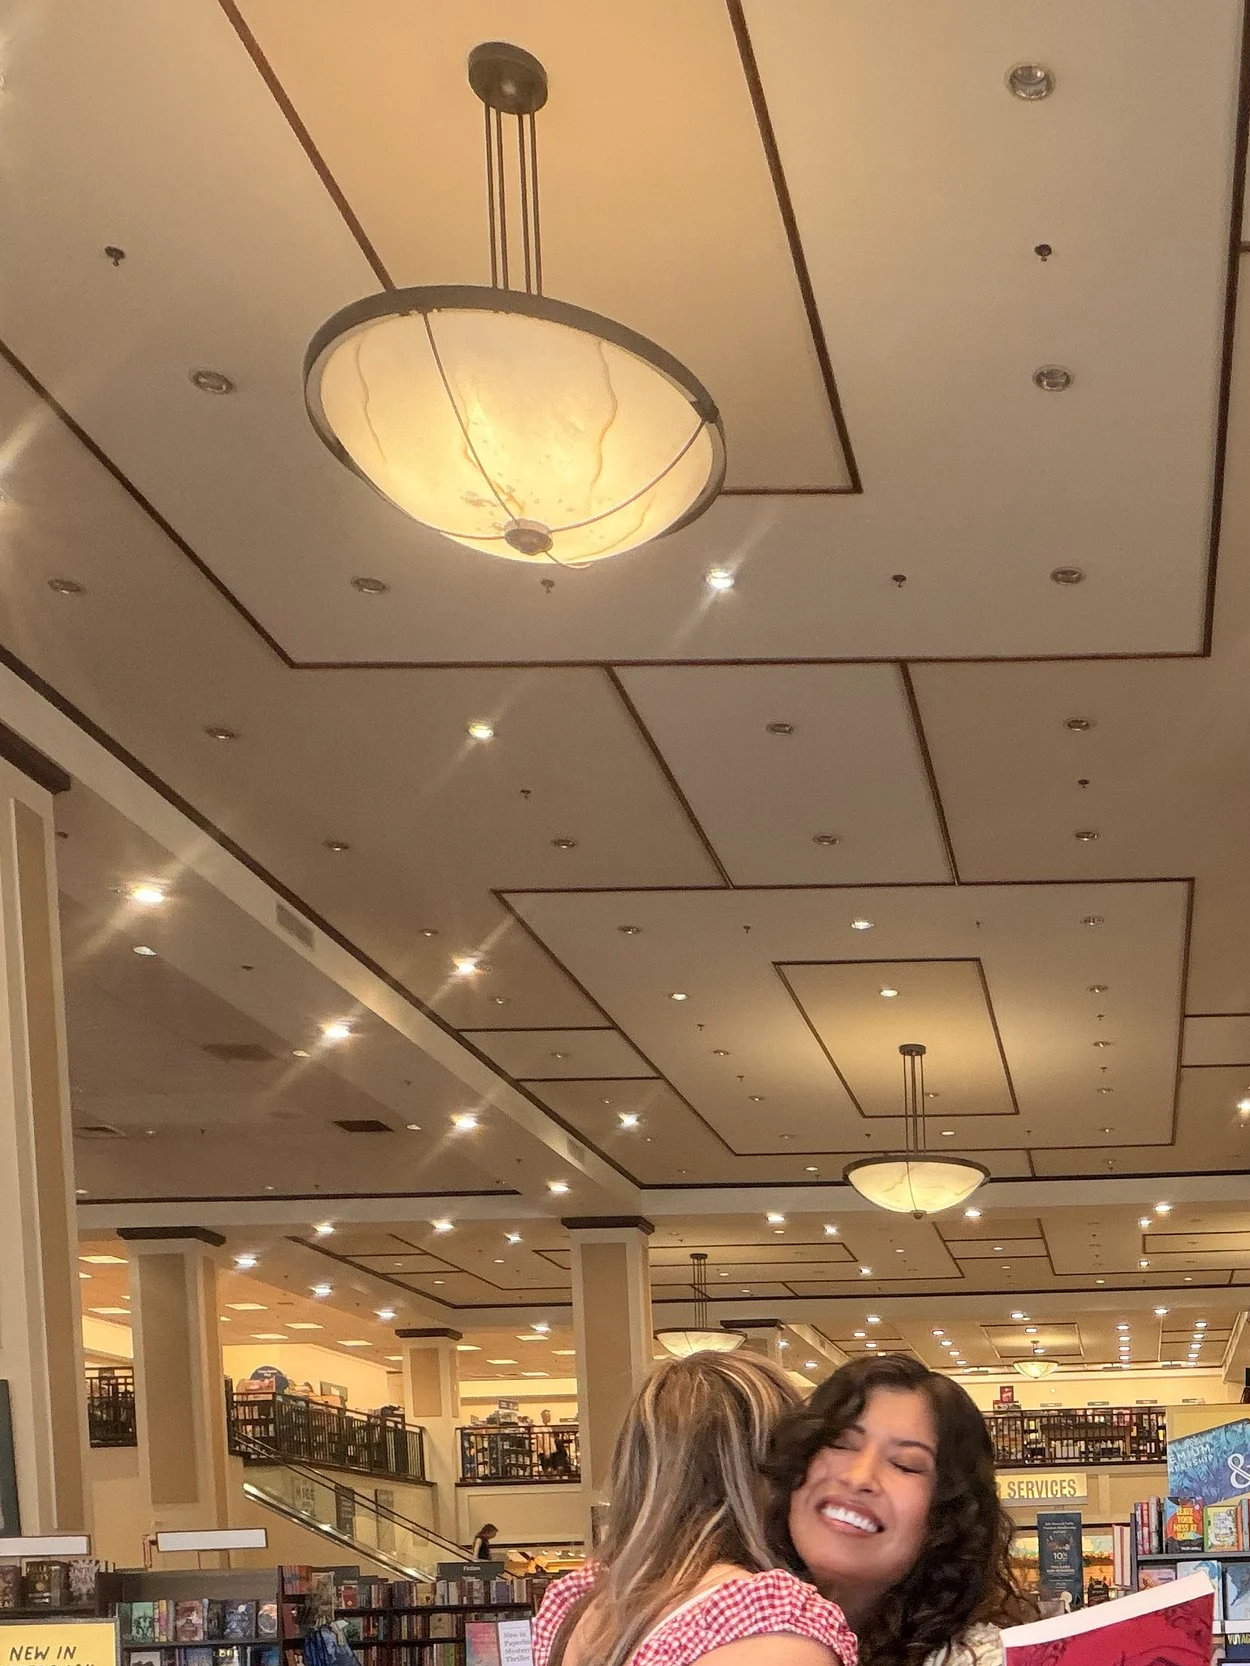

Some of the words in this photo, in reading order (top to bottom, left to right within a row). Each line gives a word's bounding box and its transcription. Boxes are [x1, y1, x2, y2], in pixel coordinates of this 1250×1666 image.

[1007, 1479, 1077, 1499] SERVICES
[10, 1645, 50, 1661] NEW
[57, 1646, 77, 1660] IN
